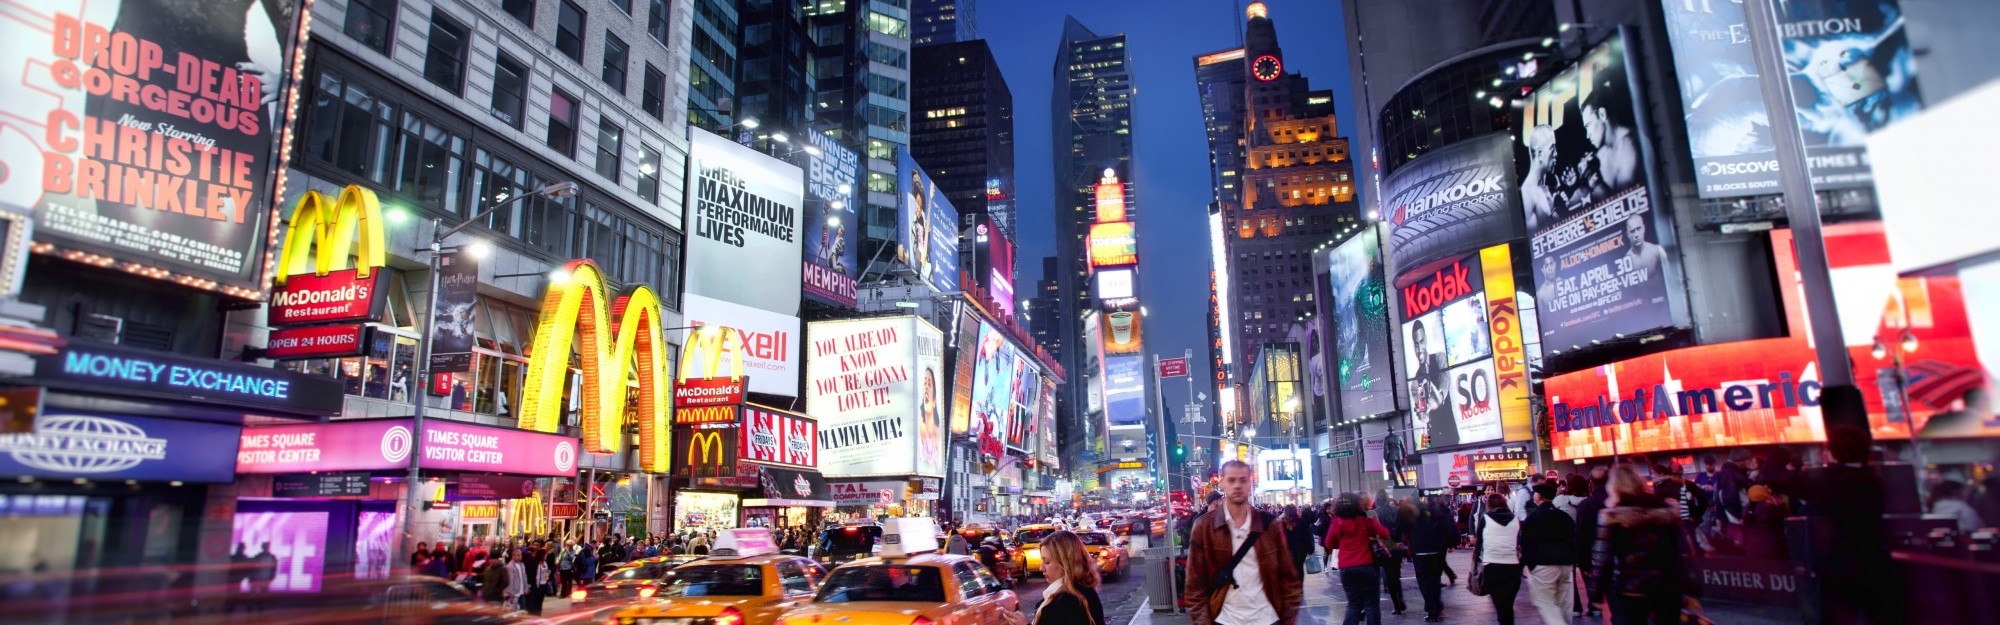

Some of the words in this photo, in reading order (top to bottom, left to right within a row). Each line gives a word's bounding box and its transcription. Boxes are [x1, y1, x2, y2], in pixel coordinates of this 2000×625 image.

[1699, 31, 1724, 42] THE
[52, 12, 261, 112] DROP-DEAD
[50, 59, 260, 136] GORGEOUS
[117, 113, 153, 132] Now
[155, 121, 217, 151] Starring
[808, 127, 857, 168] WINNER!
[45, 108, 254, 189] CHRISTIE
[1807, 154, 1857, 168] TIMES
[42, 151, 253, 224] BRINKLEY
[699, 160, 746, 188] WHERE
[810, 155, 855, 198] BEST
[1706, 184, 1712, 192] 2
[1713, 182, 1747, 191] BLOCKS
[1748, 180, 1778, 189] SOUTH
[698, 176, 794, 229] MAXIMUM
[1418, 206, 1449, 222] driving
[1451, 193, 1504, 210] emotion
[696, 215, 745, 248] LIVES
[697, 199, 794, 243] PERFORMANCE
[1532, 217, 1586, 256] ST-PIERRE
[1593, 190, 1649, 228] SHIELDS
[1092, 255, 1138, 266] TOSHIBA
[1560, 253, 1581, 271] ALDO
[1586, 234, 1625, 261] HOMINICK
[803, 260, 857, 300] MEMPHIS
[1403, 261, 1472, 318] Kodak
[1548, 295, 1568, 313] LIVE
[1568, 291, 1581, 306] ON
[1581, 267, 1648, 302] PAY-PER-VIEW
[1556, 276, 1579, 297] SAT.
[1580, 264, 1614, 289] APRIL
[1614, 256, 1633, 276] 30
[271, 284, 368, 308] McDonald's
[284, 304, 350, 318] Restaurant
[269, 337, 298, 349] OPEN
[301, 335, 314, 346] 24
[317, 333, 355, 346] HOURS
[815, 339, 840, 358] YOU
[842, 326, 898, 354] ALREADY
[1489, 297, 1523, 391] Kodak
[64, 351, 166, 383] MONEY
[169, 366, 290, 399] EXCHANGE
[840, 350, 878, 373] KNOW
[676, 385, 740, 398] McDonald's
[816, 374, 862, 396] YOU'RE
[864, 365, 908, 388] GONNA
[1457, 367, 1490, 411] SO
[686, 396, 729, 404] Restaurant
[837, 389, 870, 413] LOVE
[872, 386, 891, 405] IT!
[1554, 396, 1616, 432] Bank
[1619, 388, 1647, 423] of
[67, 438, 166, 456] EXCHANGE
[272, 432, 316, 447] SQUARE
[427, 430, 455, 446] TIMES
[458, 432, 499, 449] SQUARE
[818, 424, 870, 451] MAMMA
[872, 416, 903, 443] MIA!
[281, 449, 321, 463] CENTER
[425, 447, 465, 462] VISITOR
[467, 449, 503, 464] CENTER
[1473, 453, 1528, 461] MARQUIS
[1475, 469, 1527, 481] WONDERLAND
[1703, 569, 1764, 589] FATHER
[1769, 573, 1796, 592] DU
